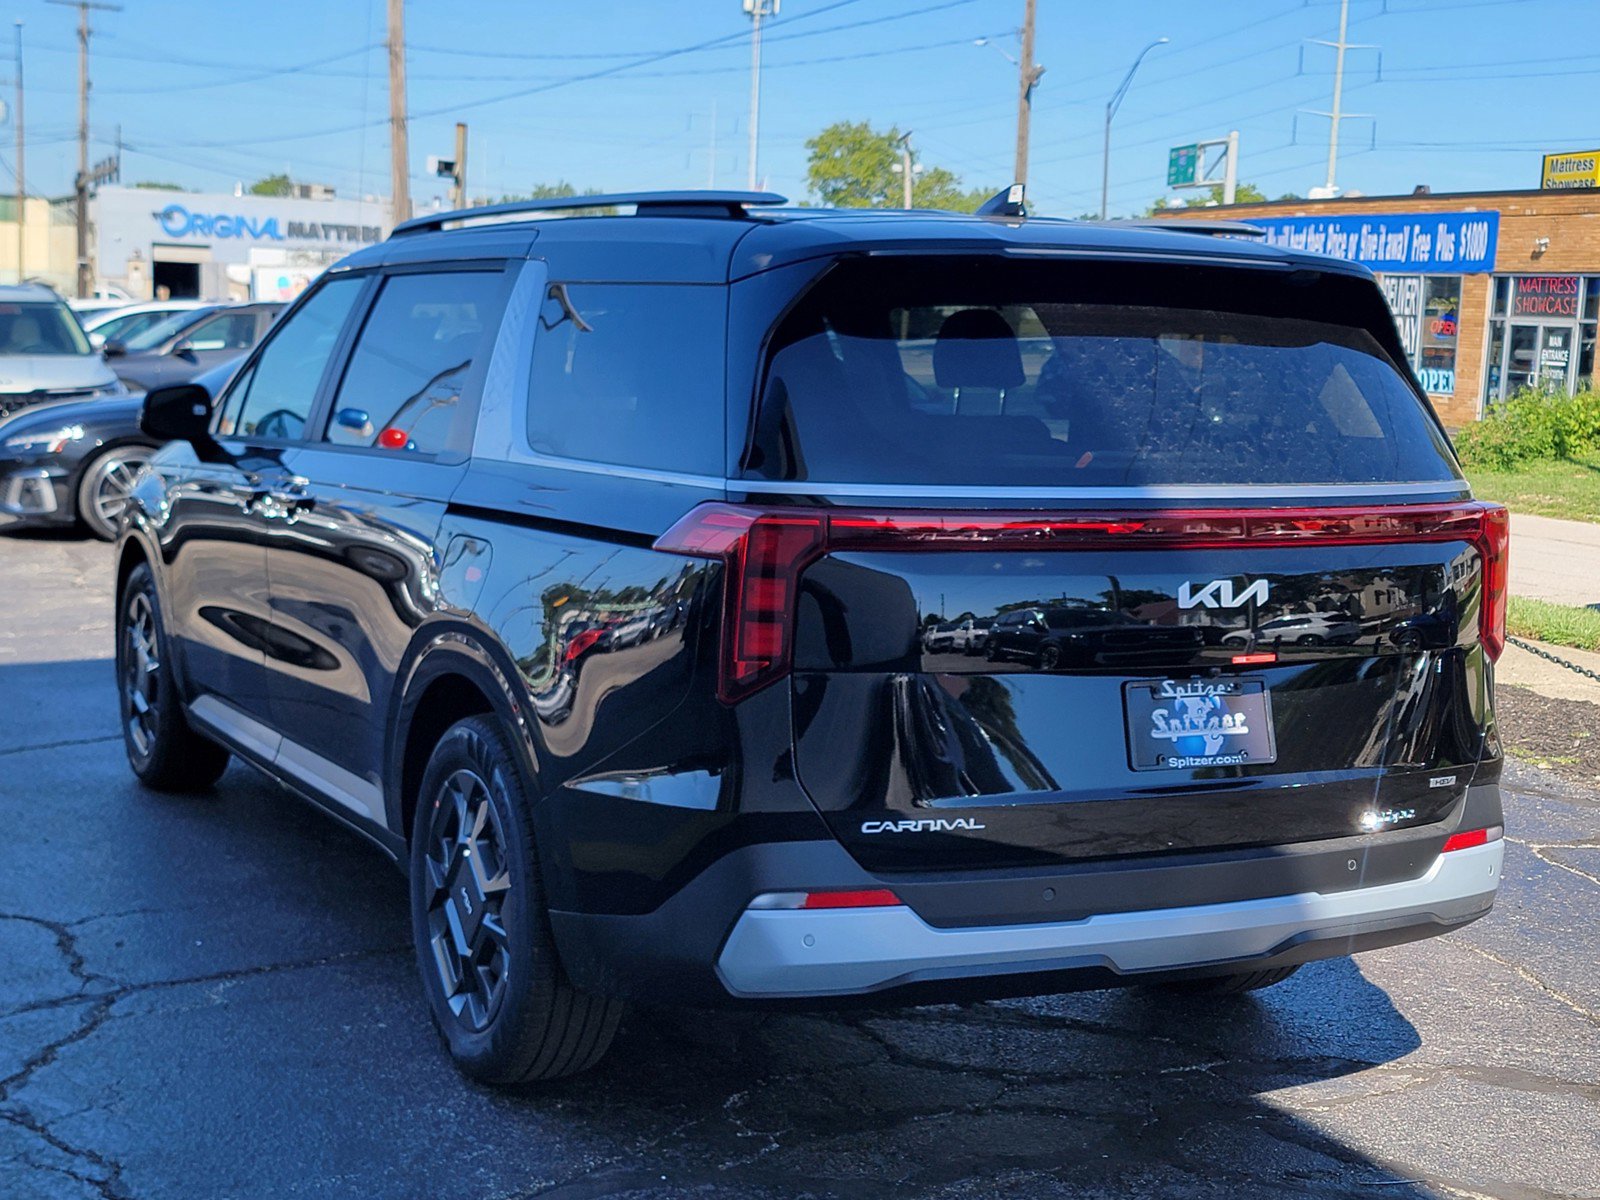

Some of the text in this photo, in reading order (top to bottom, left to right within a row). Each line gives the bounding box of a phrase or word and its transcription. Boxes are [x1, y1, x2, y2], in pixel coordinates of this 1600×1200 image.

[1551, 158, 1594, 173] Mattress
[1546, 178, 1596, 189] Showcase
[161, 204, 284, 240] ORIGINAL
[1327, 224, 1347, 259] Price
[1347, 232, 1358, 260] or
[1359, 223, 1378, 261] Give
[1386, 225, 1410, 263] away
[1411, 224, 1431, 262] Free
[1435, 223, 1456, 262] Plus
[1459, 221, 1489, 262] $1000
[1519, 277, 1578, 294] MATTRESS
[1515, 296, 1578, 315] SHOWCASE
[1430, 320, 1457, 335] OPEN
[1549, 336, 1563, 347] MAIN
[1541, 348, 1569, 362] ENTRANCE
[1418, 368, 1455, 393] OPEN
[1178, 579, 1269, 609] KIA
[1151, 709, 1249, 742] Spitzer
[1168, 754, 1244, 769] Spitzer.com
[861, 818, 986, 833] CARNIVAL
